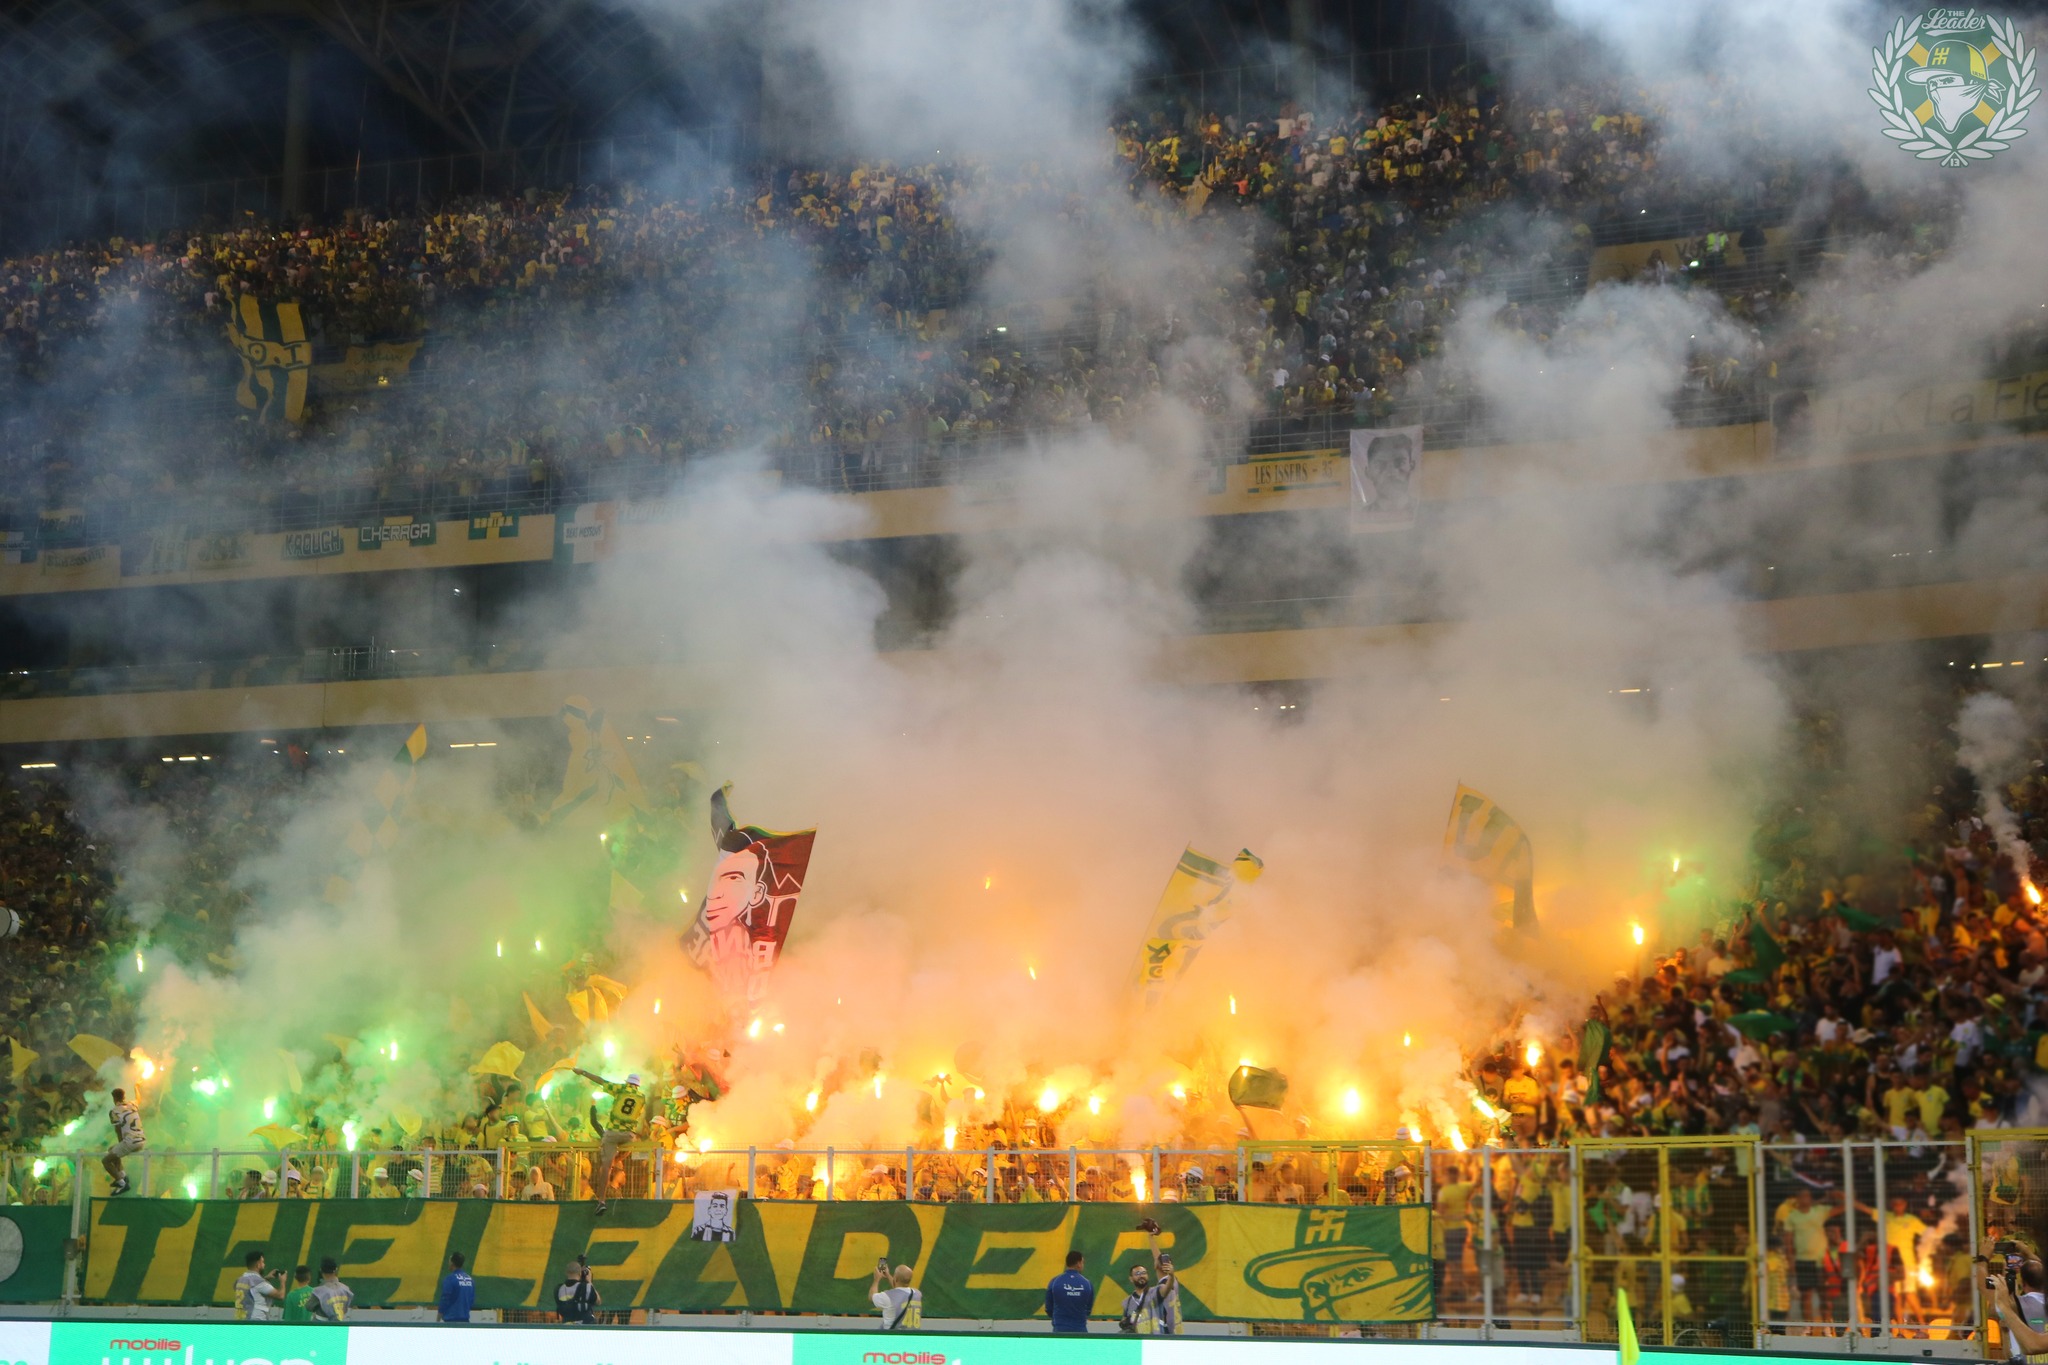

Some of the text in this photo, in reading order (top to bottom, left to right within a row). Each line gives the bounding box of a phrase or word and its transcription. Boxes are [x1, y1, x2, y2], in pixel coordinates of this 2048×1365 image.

[1255, 464, 1272, 486] LES
[1274, 462, 1309, 484] ISSERS
[360, 523, 431, 542] CHERAGA
[621, 1098, 636, 1115] 8
[100, 1201, 422, 1308] THE
[110, 1339, 181, 1351] mobilis
[863, 1352, 946, 1365] mobilis
